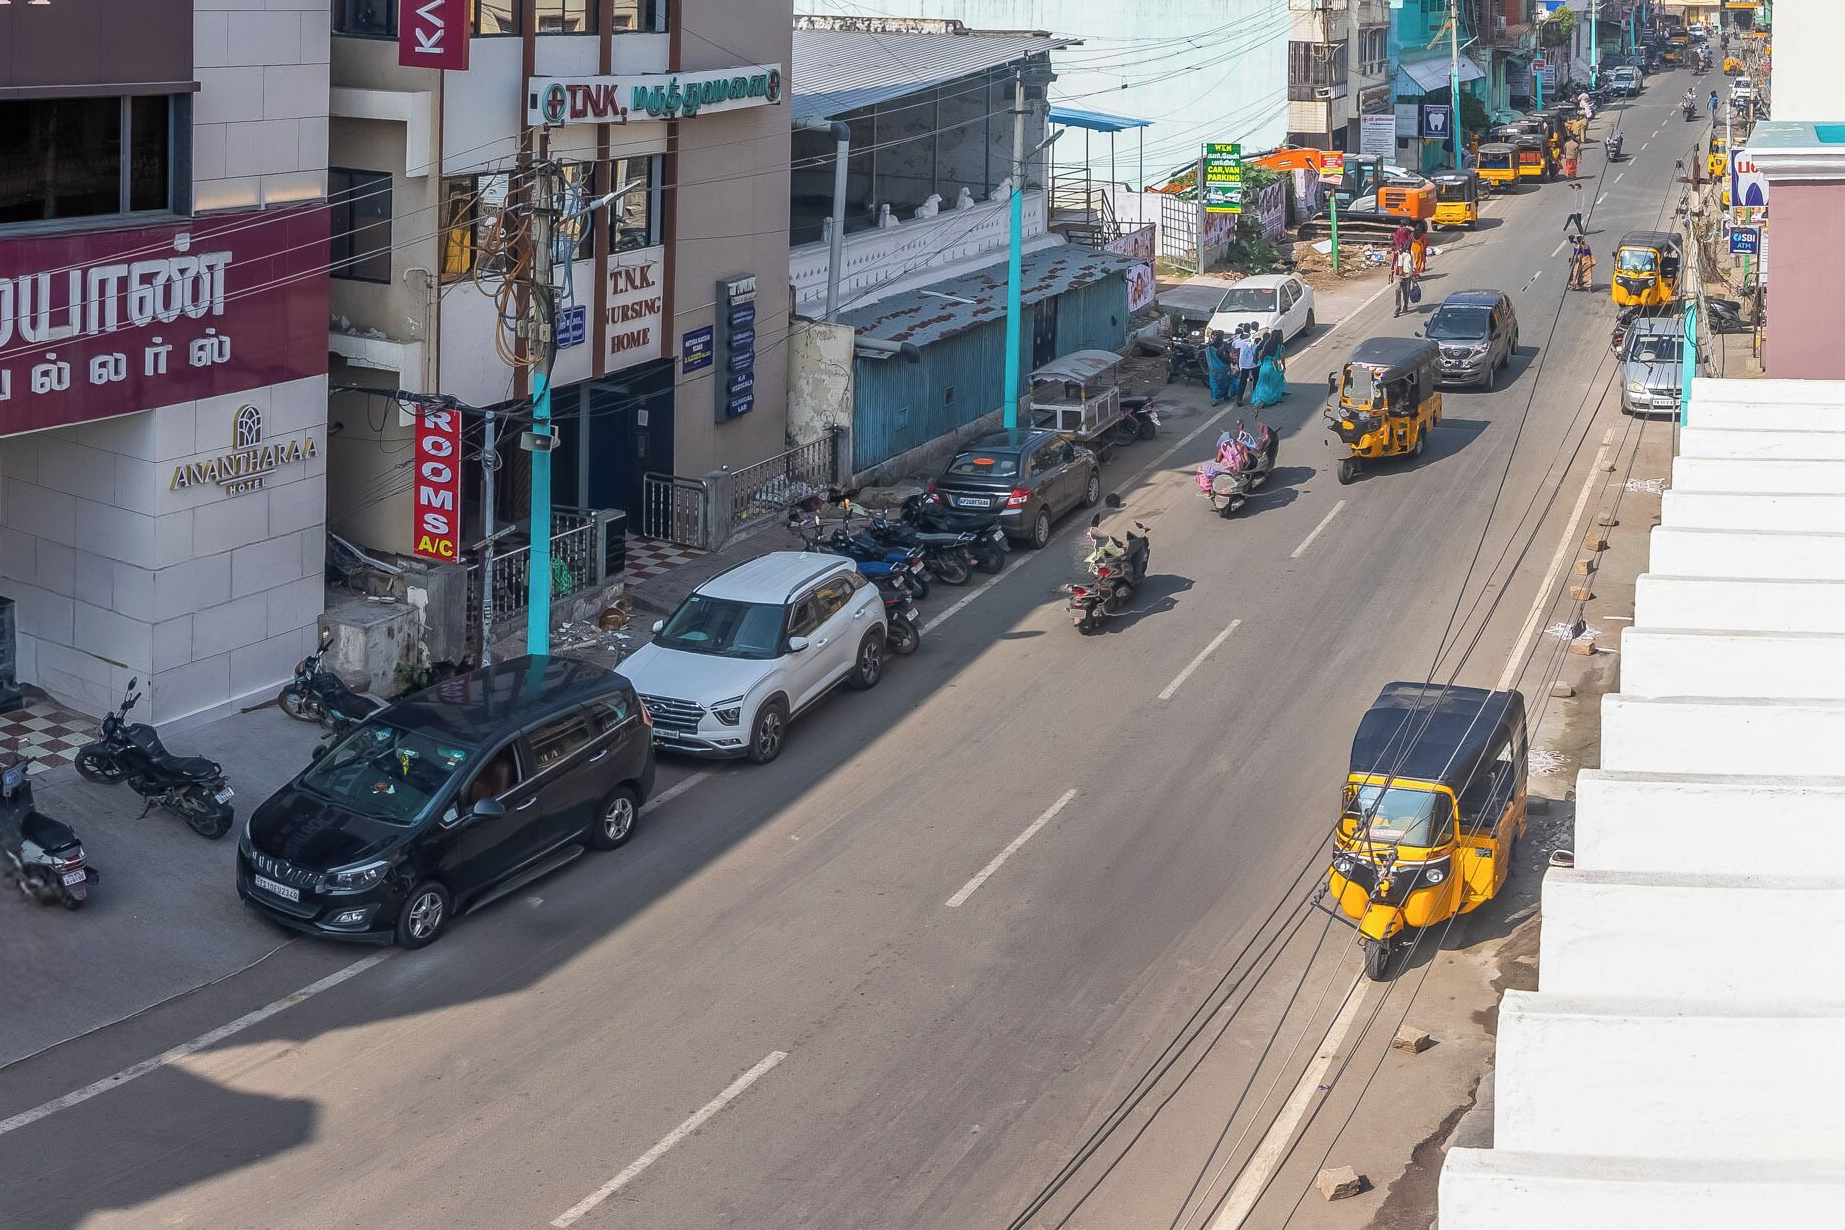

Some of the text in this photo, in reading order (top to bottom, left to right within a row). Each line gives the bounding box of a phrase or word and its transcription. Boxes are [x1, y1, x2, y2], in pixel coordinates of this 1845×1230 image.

[1741, 233, 1756, 243] SBI
[610, 265, 656, 296] T.N.K.
[610, 327, 650, 355] HOME
[731, 379, 754, 392] MEDICALS
[731, 394, 754, 407] CLINICAL
[737, 403, 747, 412] LAB
[169, 437, 319, 491] ANANTHARAA
[419, 409, 454, 536] ROOMS
[226, 478, 267, 496] HOTEL
[418, 535, 454, 557] A/C
